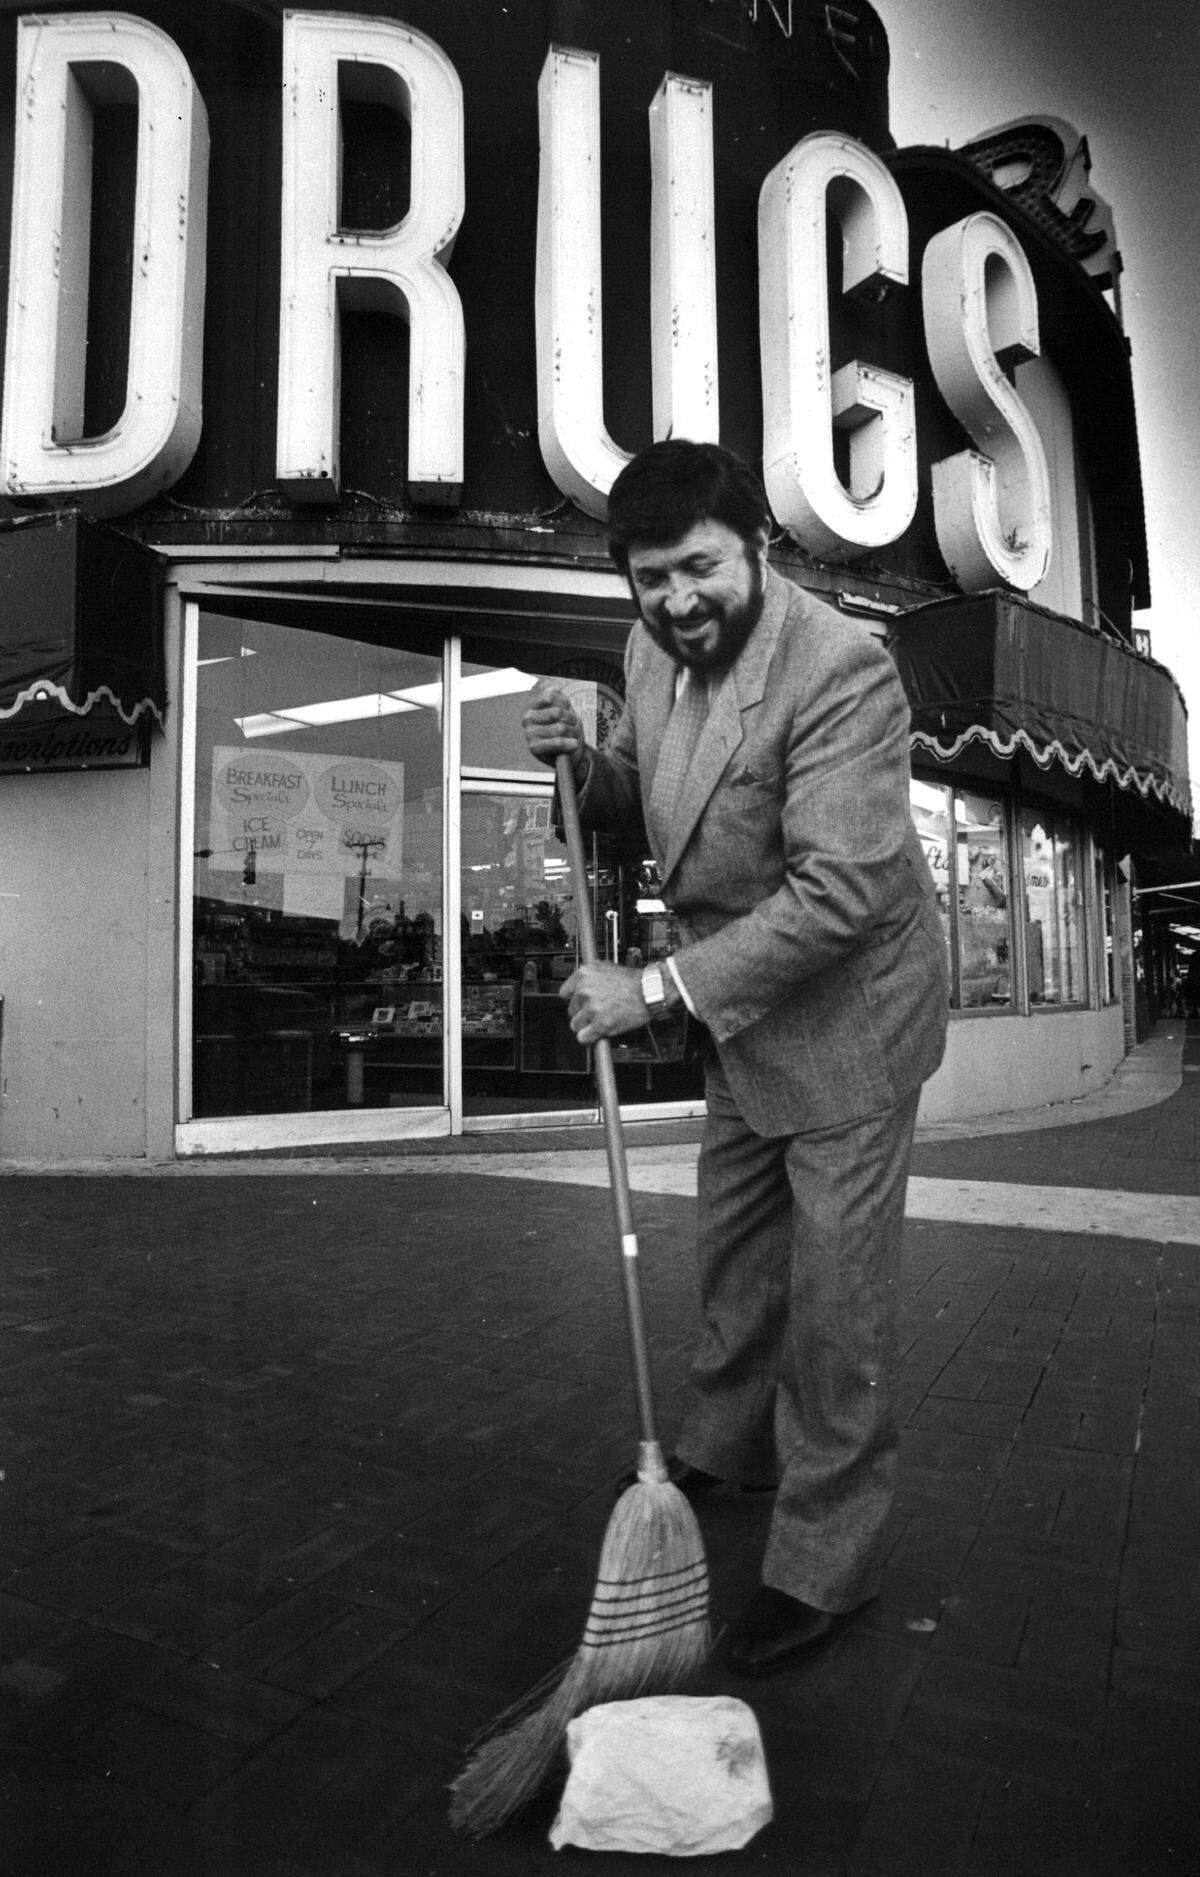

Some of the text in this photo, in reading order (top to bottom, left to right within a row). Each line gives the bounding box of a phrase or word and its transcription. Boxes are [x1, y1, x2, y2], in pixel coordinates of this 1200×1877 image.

[0, 8, 1054, 593] DRUGS
[225, 767, 303, 790] BREAKFAST
[331, 776, 387, 796] LUNCH
[243, 816, 270, 832] ICE
[232, 833, 282, 852] CREAM
